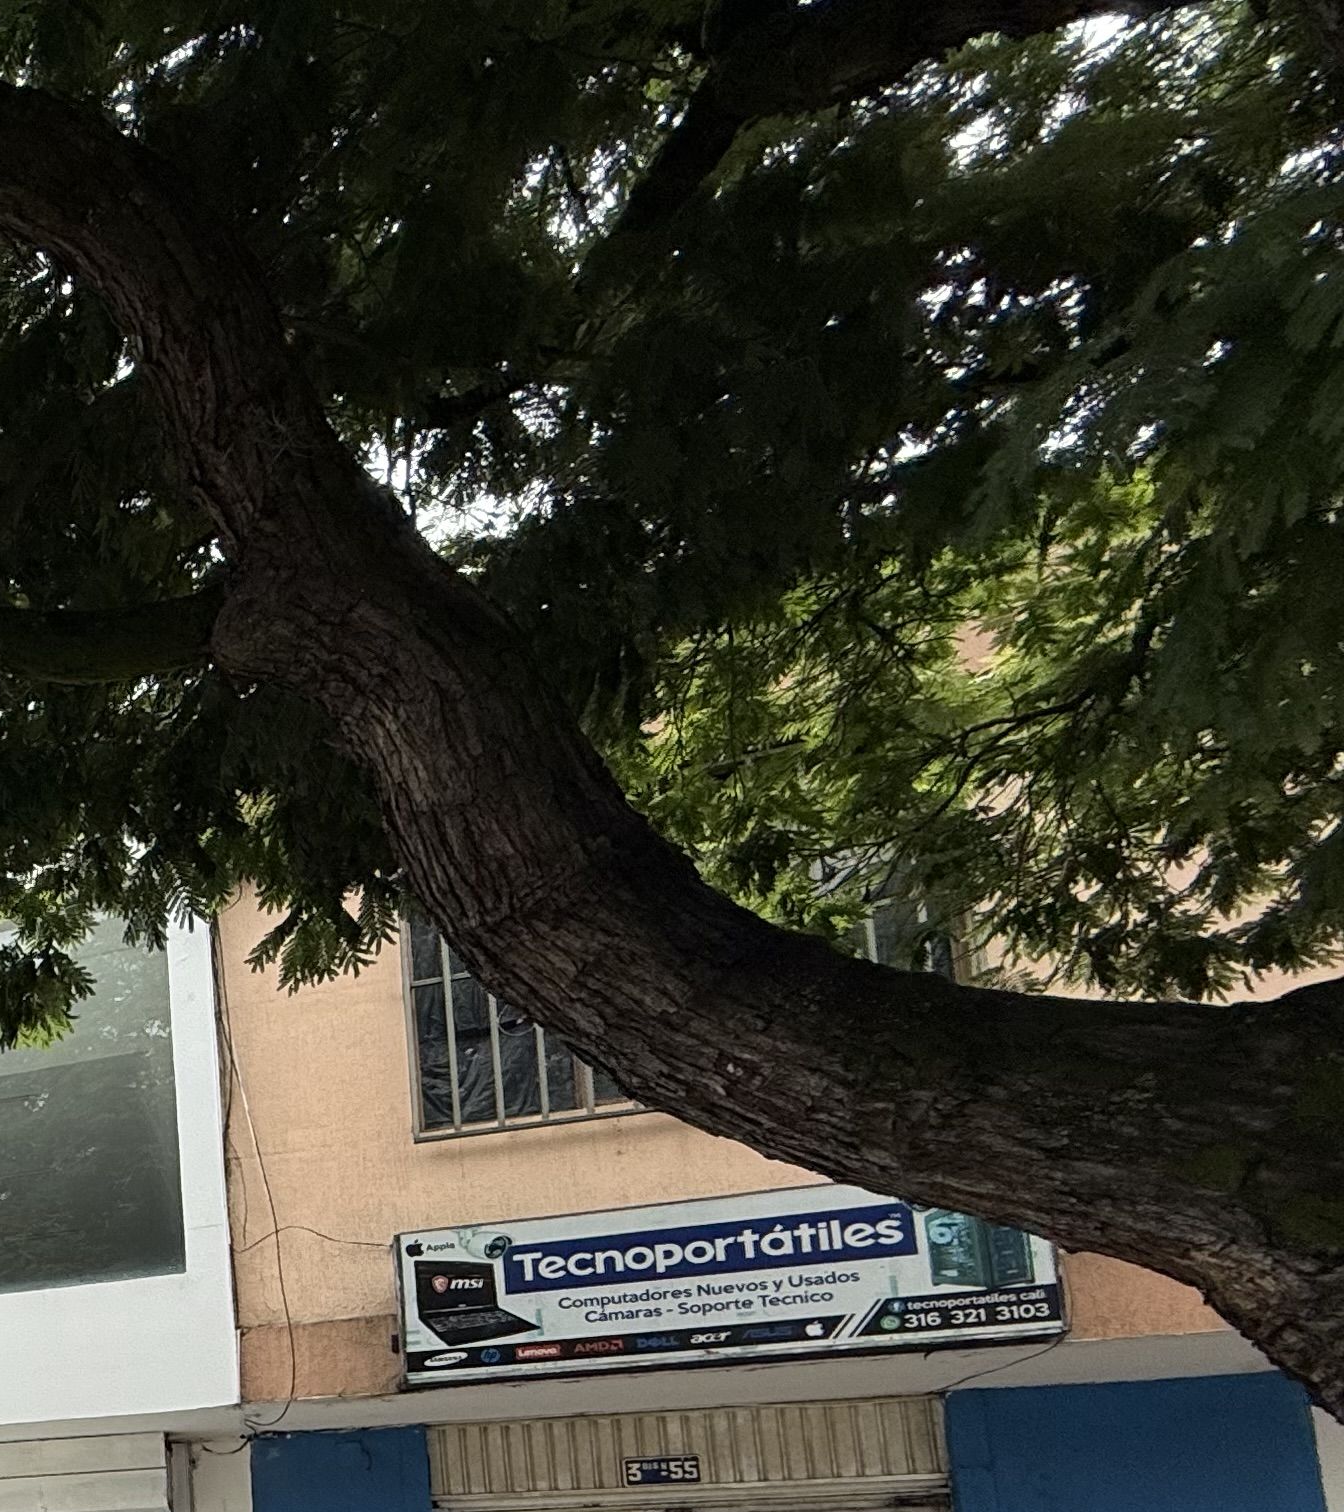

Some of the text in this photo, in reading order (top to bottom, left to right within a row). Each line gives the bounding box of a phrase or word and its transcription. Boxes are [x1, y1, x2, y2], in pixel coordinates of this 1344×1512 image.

[426, 1242, 456, 1252] Apple
[512, 1218, 904, 1281] Tecnoportátiles
[450, 1276, 484, 1290] msi
[558, 1270, 861, 1311] Computadores Nuevos y Usados
[584, 1307, 662, 1324] Cámaras
[678, 1298, 754, 1318] Soporte
[758, 1290, 834, 1308] Tecnico
[906, 1288, 1046, 1312] tecnoportatiles cali
[904, 1302, 1051, 1329] 316 321 3103
[574, 1341, 610, 1354] AMD
[690, 1330, 732, 1344] acer
[628, 1462, 642, 1482] 3
